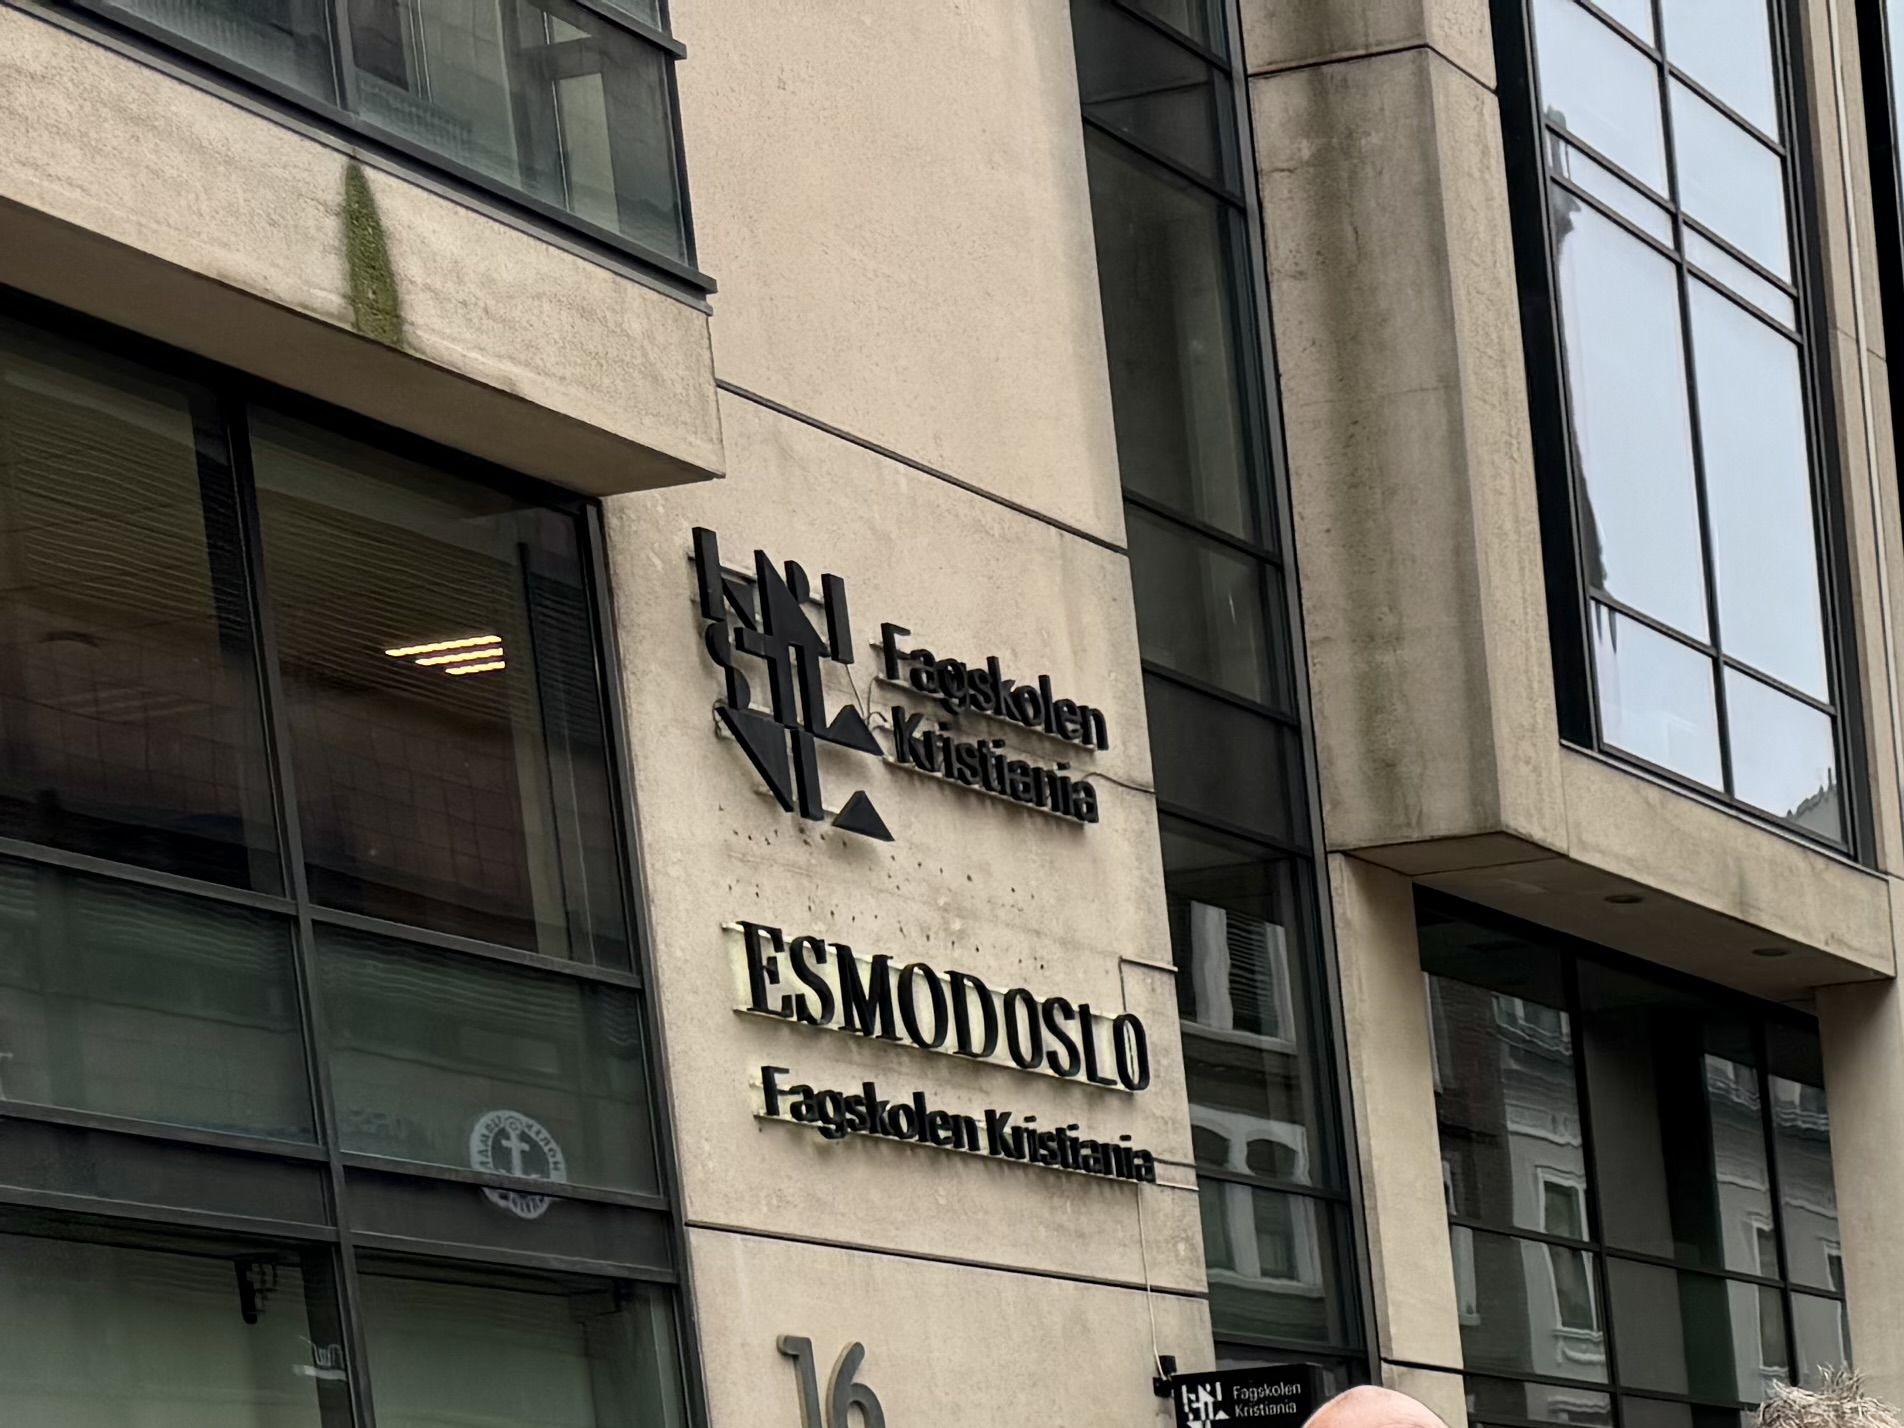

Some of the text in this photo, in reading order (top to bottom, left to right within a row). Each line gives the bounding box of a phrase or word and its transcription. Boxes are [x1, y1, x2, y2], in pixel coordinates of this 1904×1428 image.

[881, 622, 1109, 751] Fagskolen
[890, 705, 1099, 824] Kristiania
[761, 1065, 1157, 1183] Fagskolen Kristiania
[1232, 1381, 1301, 1401] Fagskolen
[1234, 1399, 1297, 1418] Kristiania
